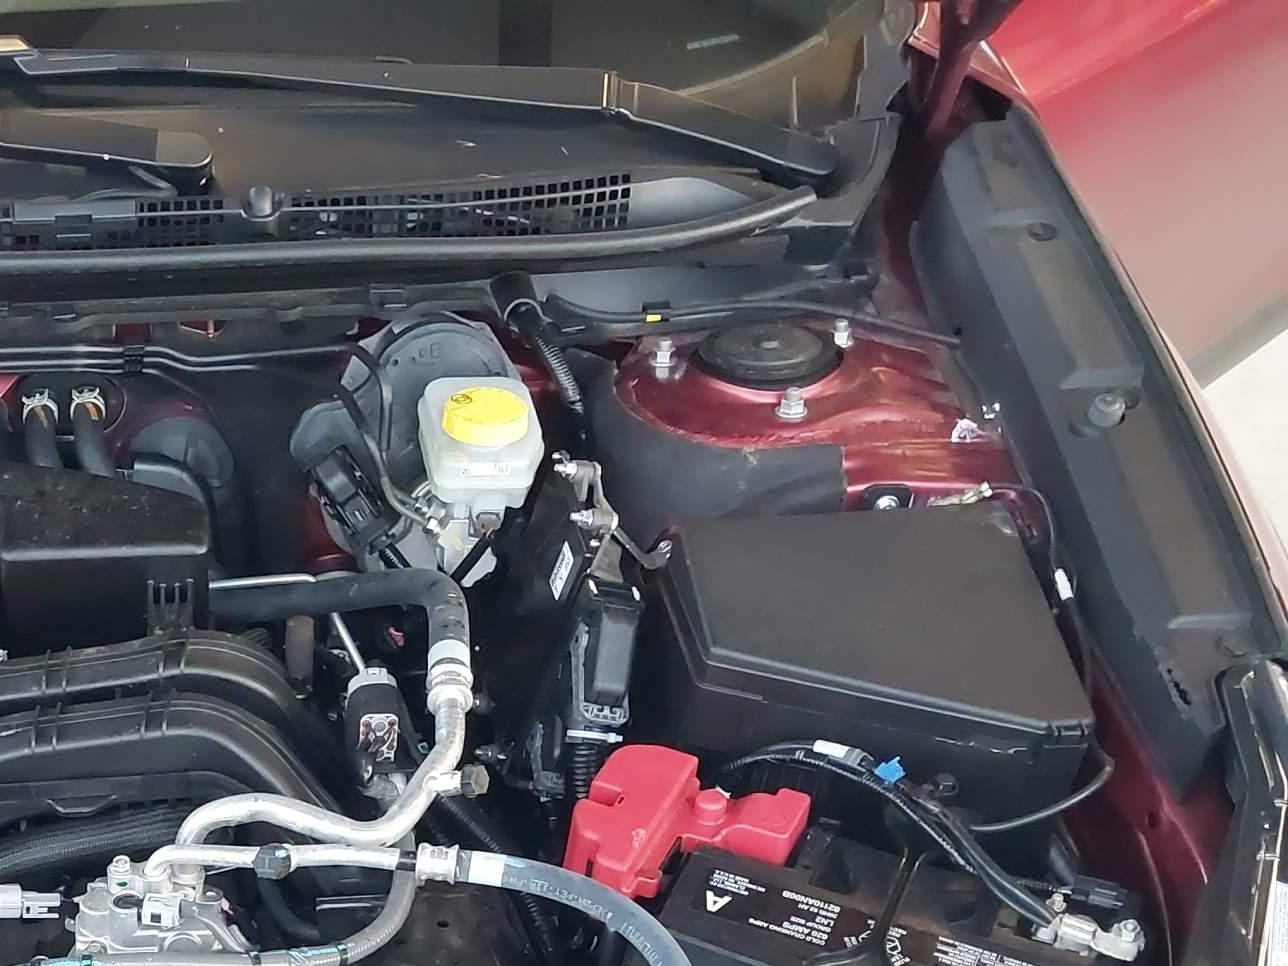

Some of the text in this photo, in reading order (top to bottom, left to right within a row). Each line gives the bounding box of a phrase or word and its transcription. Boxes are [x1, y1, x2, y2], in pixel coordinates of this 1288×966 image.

[706, 889, 732, 912] A
[790, 916, 832, 933] GROUP SIZE
[815, 915, 834, 926] LN2
[748, 917, 826, 946] COLD CRANKING AMPS
[782, 921, 829, 940] 620 AMPS
